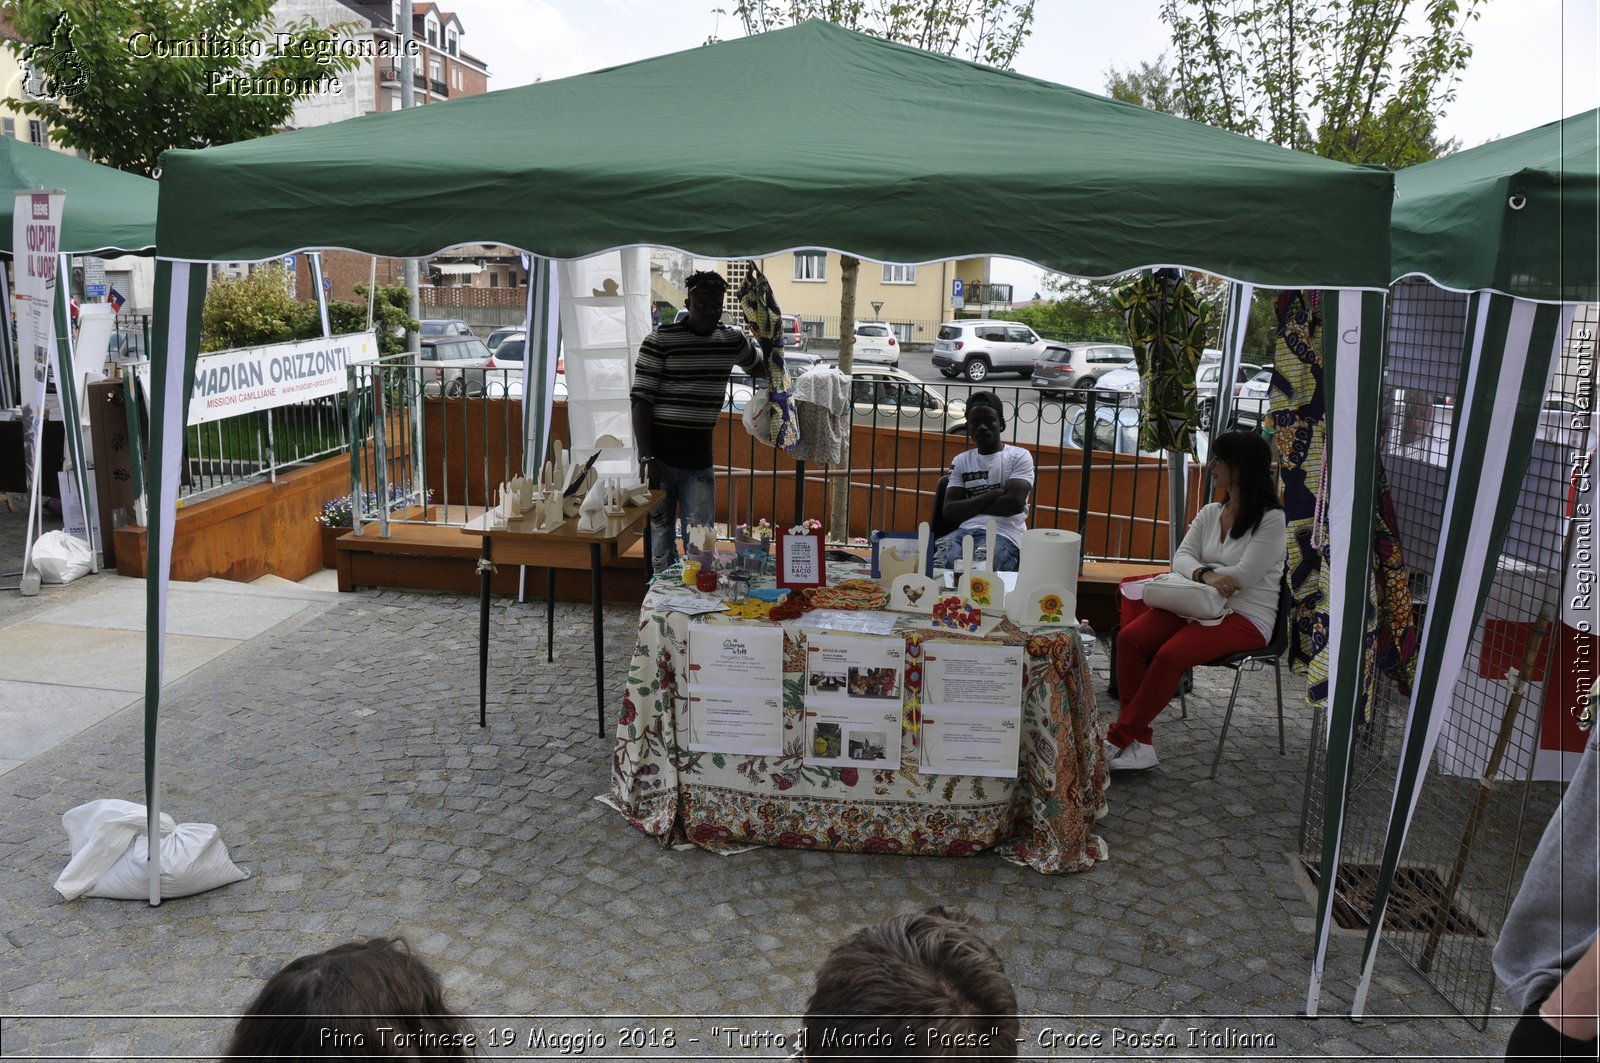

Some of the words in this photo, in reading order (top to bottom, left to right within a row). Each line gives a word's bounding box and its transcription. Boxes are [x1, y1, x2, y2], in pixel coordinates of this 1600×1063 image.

[26, 224, 56, 253] COLPITA
[28, 255, 36, 277] AL
[37, 257, 55, 279] CUORE
[284, 257, 293, 270] P
[954, 280, 962, 295] P
[191, 360, 264, 399] MADIAN
[269, 347, 349, 383] ORIZZONTI
[206, 394, 238, 409] MISSIONI
[239, 387, 276, 404] CAMILLIANE
